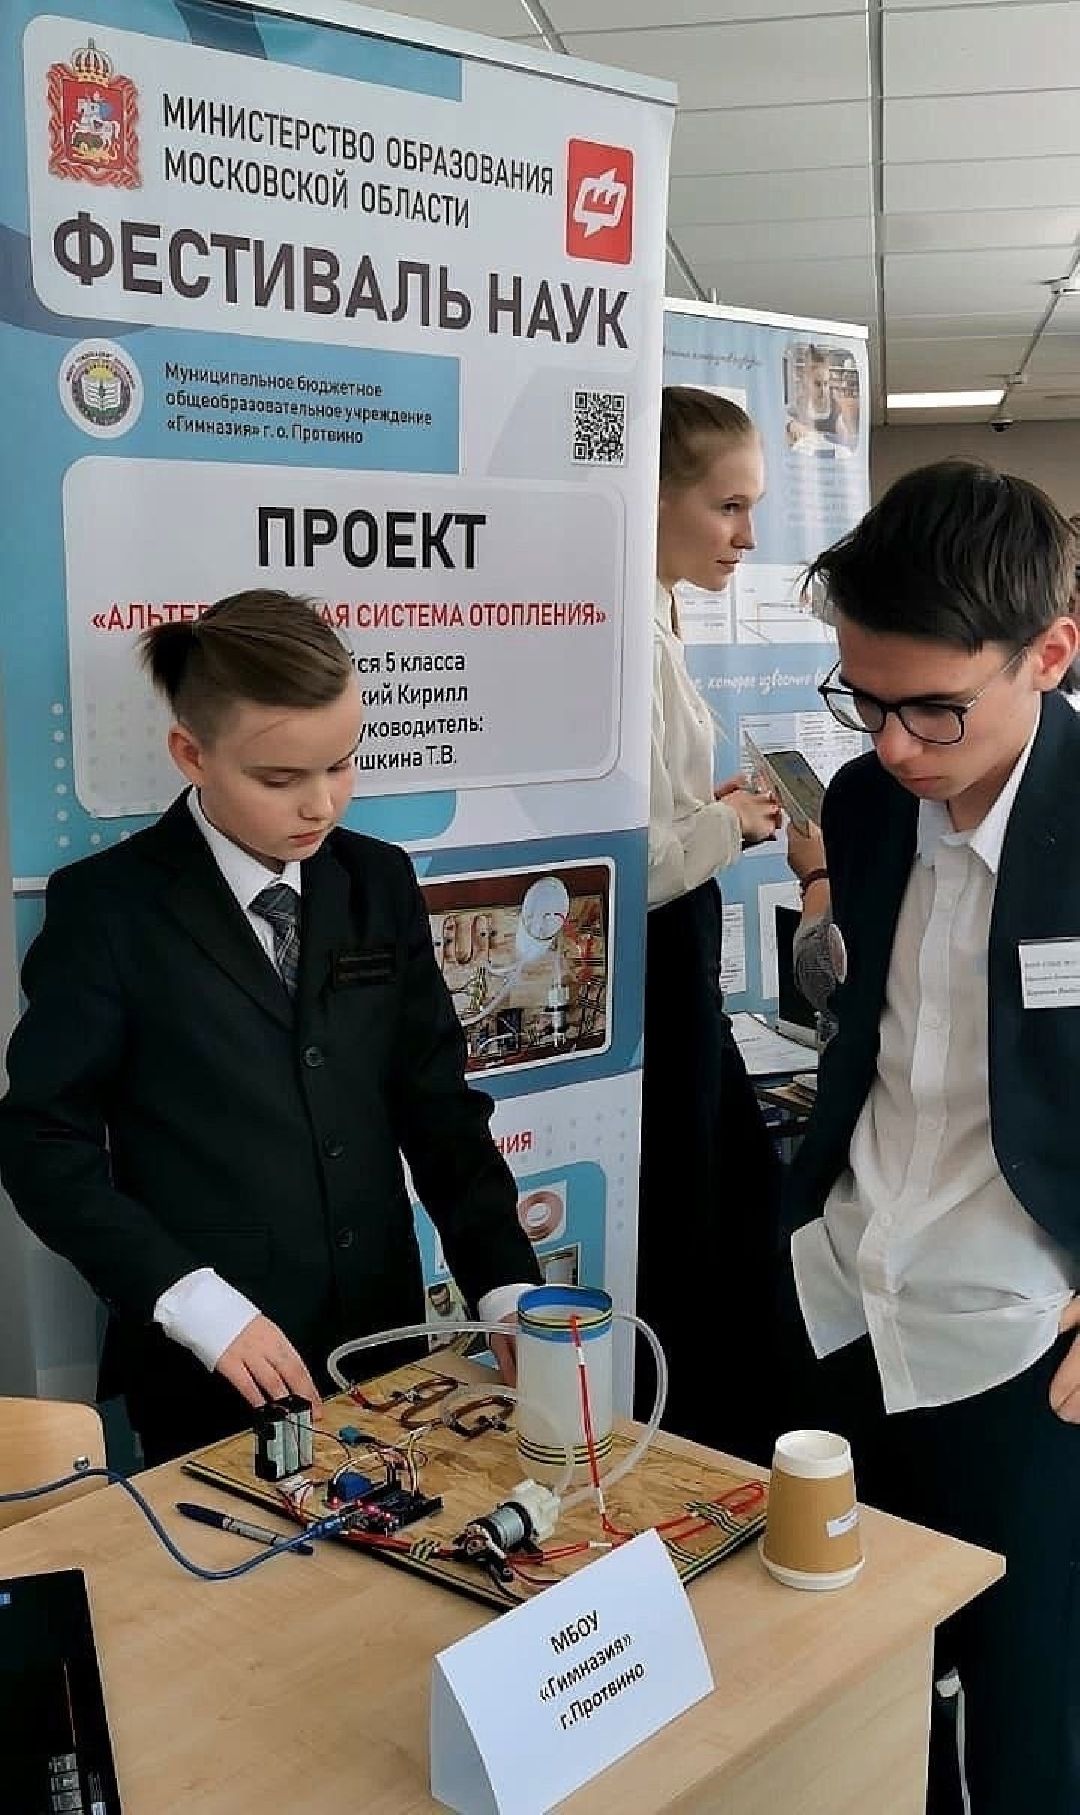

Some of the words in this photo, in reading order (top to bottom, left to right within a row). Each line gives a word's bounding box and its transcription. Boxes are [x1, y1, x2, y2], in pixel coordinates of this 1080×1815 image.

[163, 93, 374, 163] МИНИСТЕРСТВО
[386, 137, 553, 196] ОБРАЗОВАНИЯ
[165, 146, 348, 209] МОСКОВСКОЙ
[361, 181, 469, 229] ОБЛАСТИ
[52, 211, 471, 330] ФЕСТИВАЛЬ
[488, 273, 630, 349] НАУК
[165, 361, 295, 390] Муниципальное
[297, 375, 383, 397] бюджетное
[165, 389, 343, 418] общеобразовательное
[345, 406, 432, 426] учреждение
[167, 415, 260, 438] «Гимназия»
[291, 423, 363, 444] Протвино
[258, 506, 487, 569] ПРОЕКТ
[357, 604, 464, 628] СИСТЕМА
[469, 603, 606, 627] ОТОПЛЕНИЯ»
[385, 651, 396, 673] 5
[400, 655, 466, 672] класса
[361, 682, 393, 706] кий
[397, 684, 468, 710] Кирилл
[359, 716, 483, 743] уководитель:
[425, 744, 457, 766] Т.В.
[550, 1609, 599, 1655] МБОУ
[539, 1633, 632, 1702] «Гимназия»
[560, 1663, 645, 1730] г.Протвино
